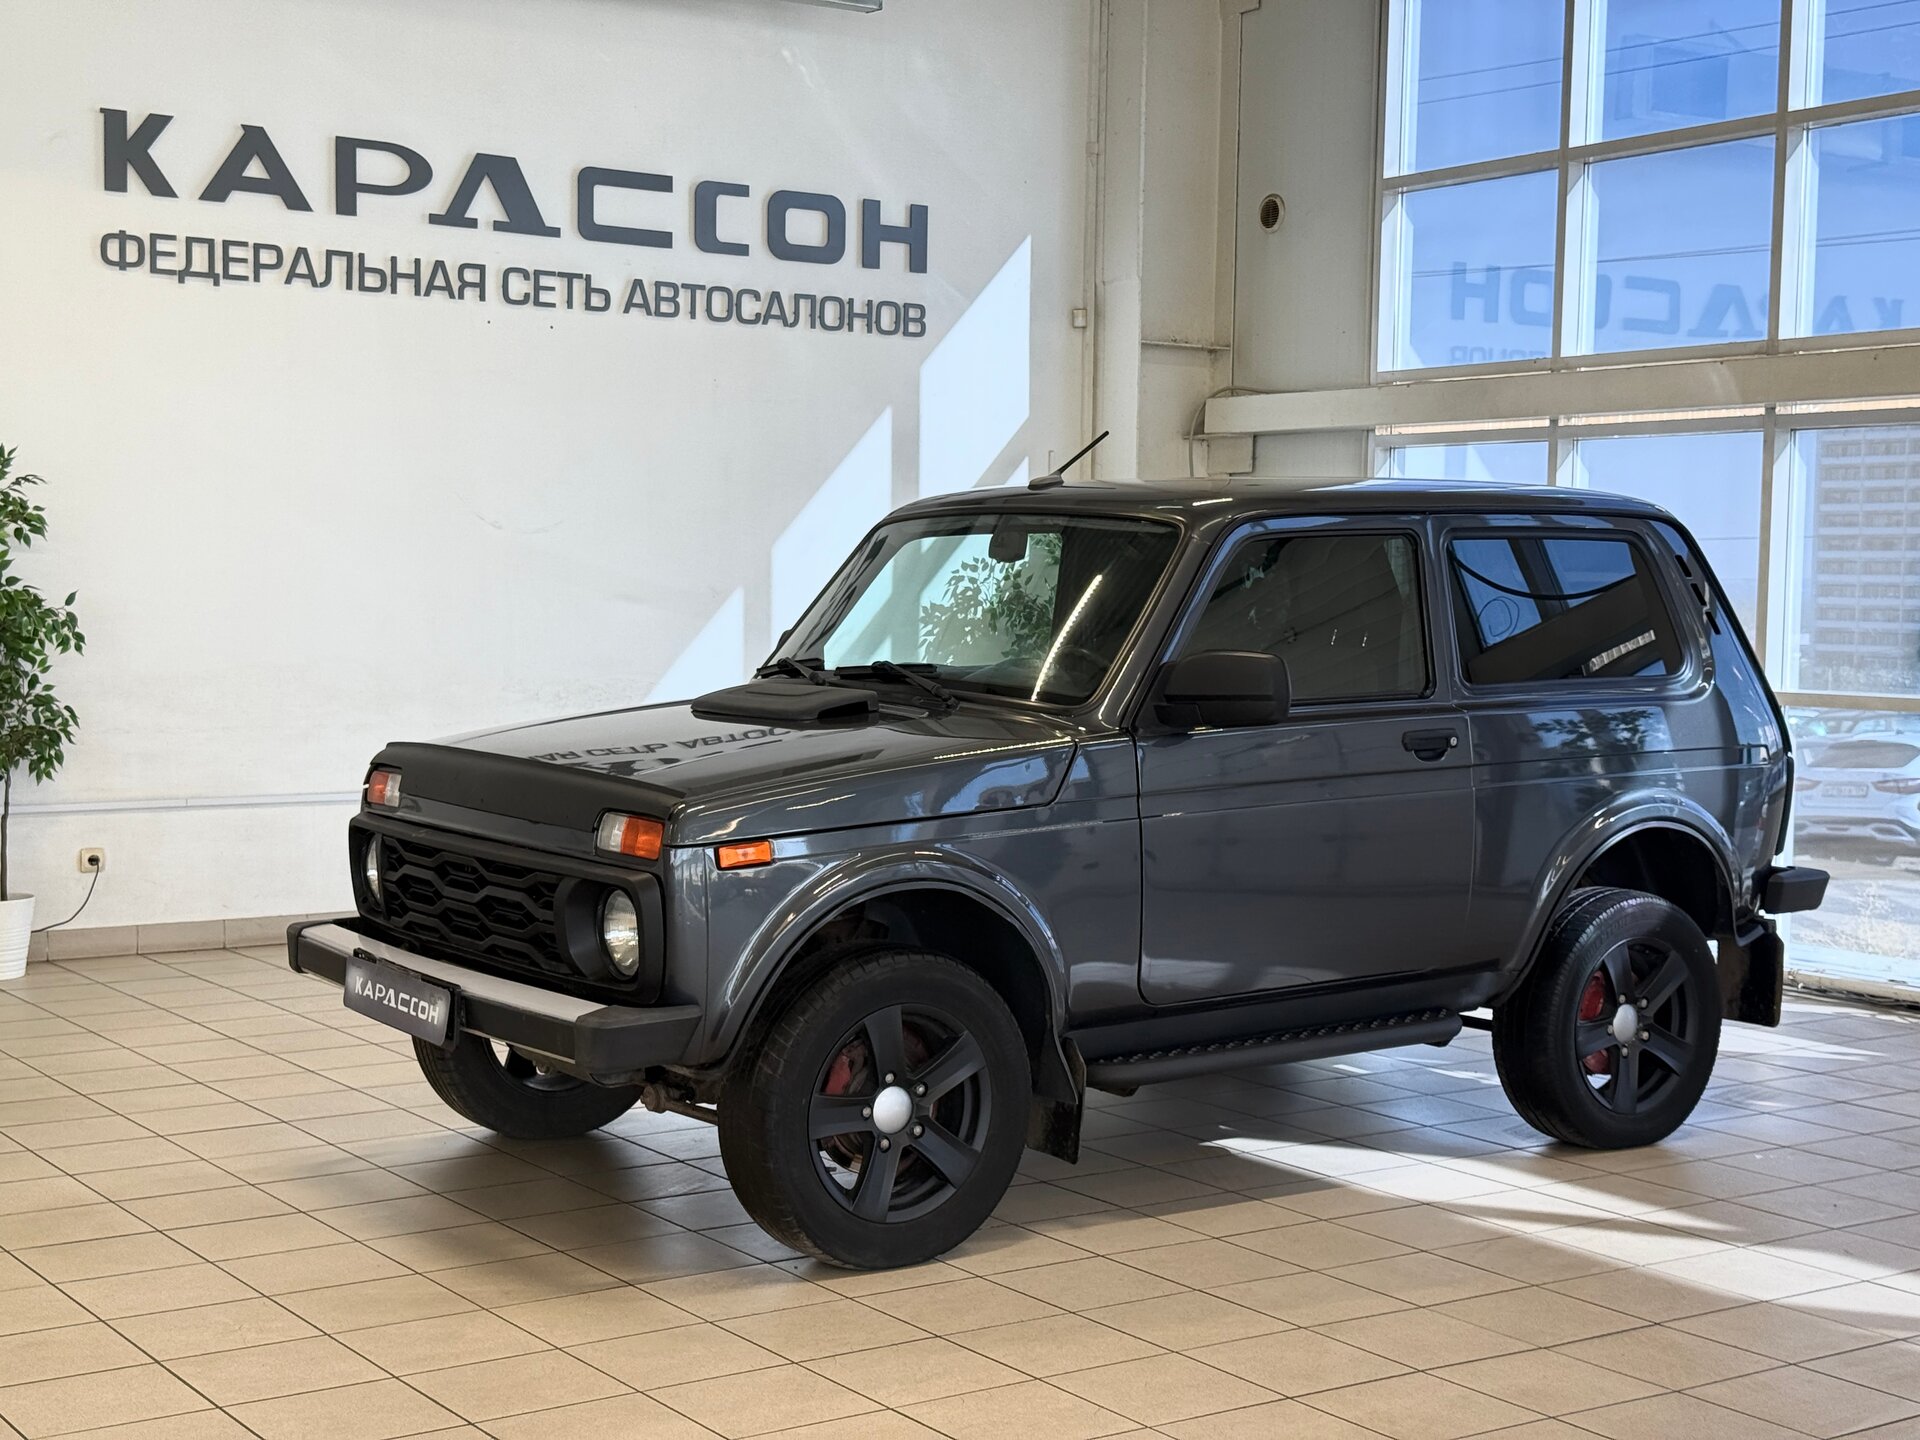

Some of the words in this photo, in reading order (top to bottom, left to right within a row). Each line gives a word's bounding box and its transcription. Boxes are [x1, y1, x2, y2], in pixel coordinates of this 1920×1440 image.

[99, 229, 487, 302] ФЕДЕРАЛЬНАЯ
[501, 266, 612, 312] СЕТЬ
[623, 278, 927, 338] АВТОСАЛОНОВ
